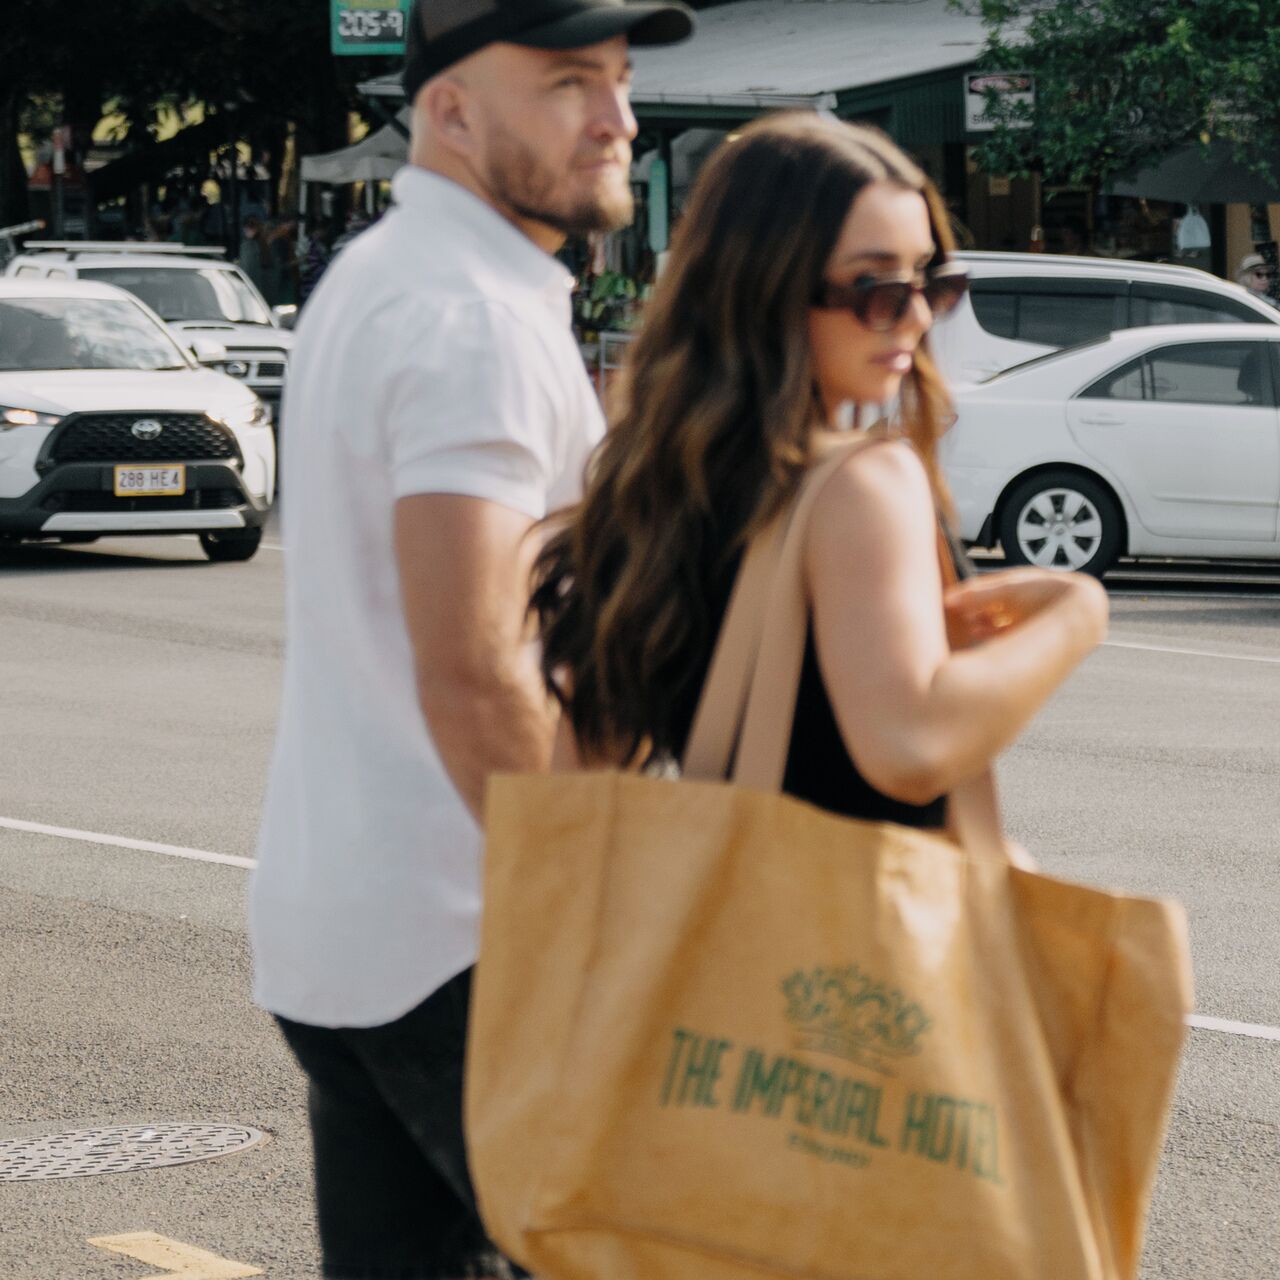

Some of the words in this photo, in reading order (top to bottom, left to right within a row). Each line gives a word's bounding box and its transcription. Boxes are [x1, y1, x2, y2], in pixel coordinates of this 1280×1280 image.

[660, 1028, 732, 1109] THE
[732, 1047, 889, 1149] IMPERIAL
[901, 1090, 1006, 1186] HOTEL
